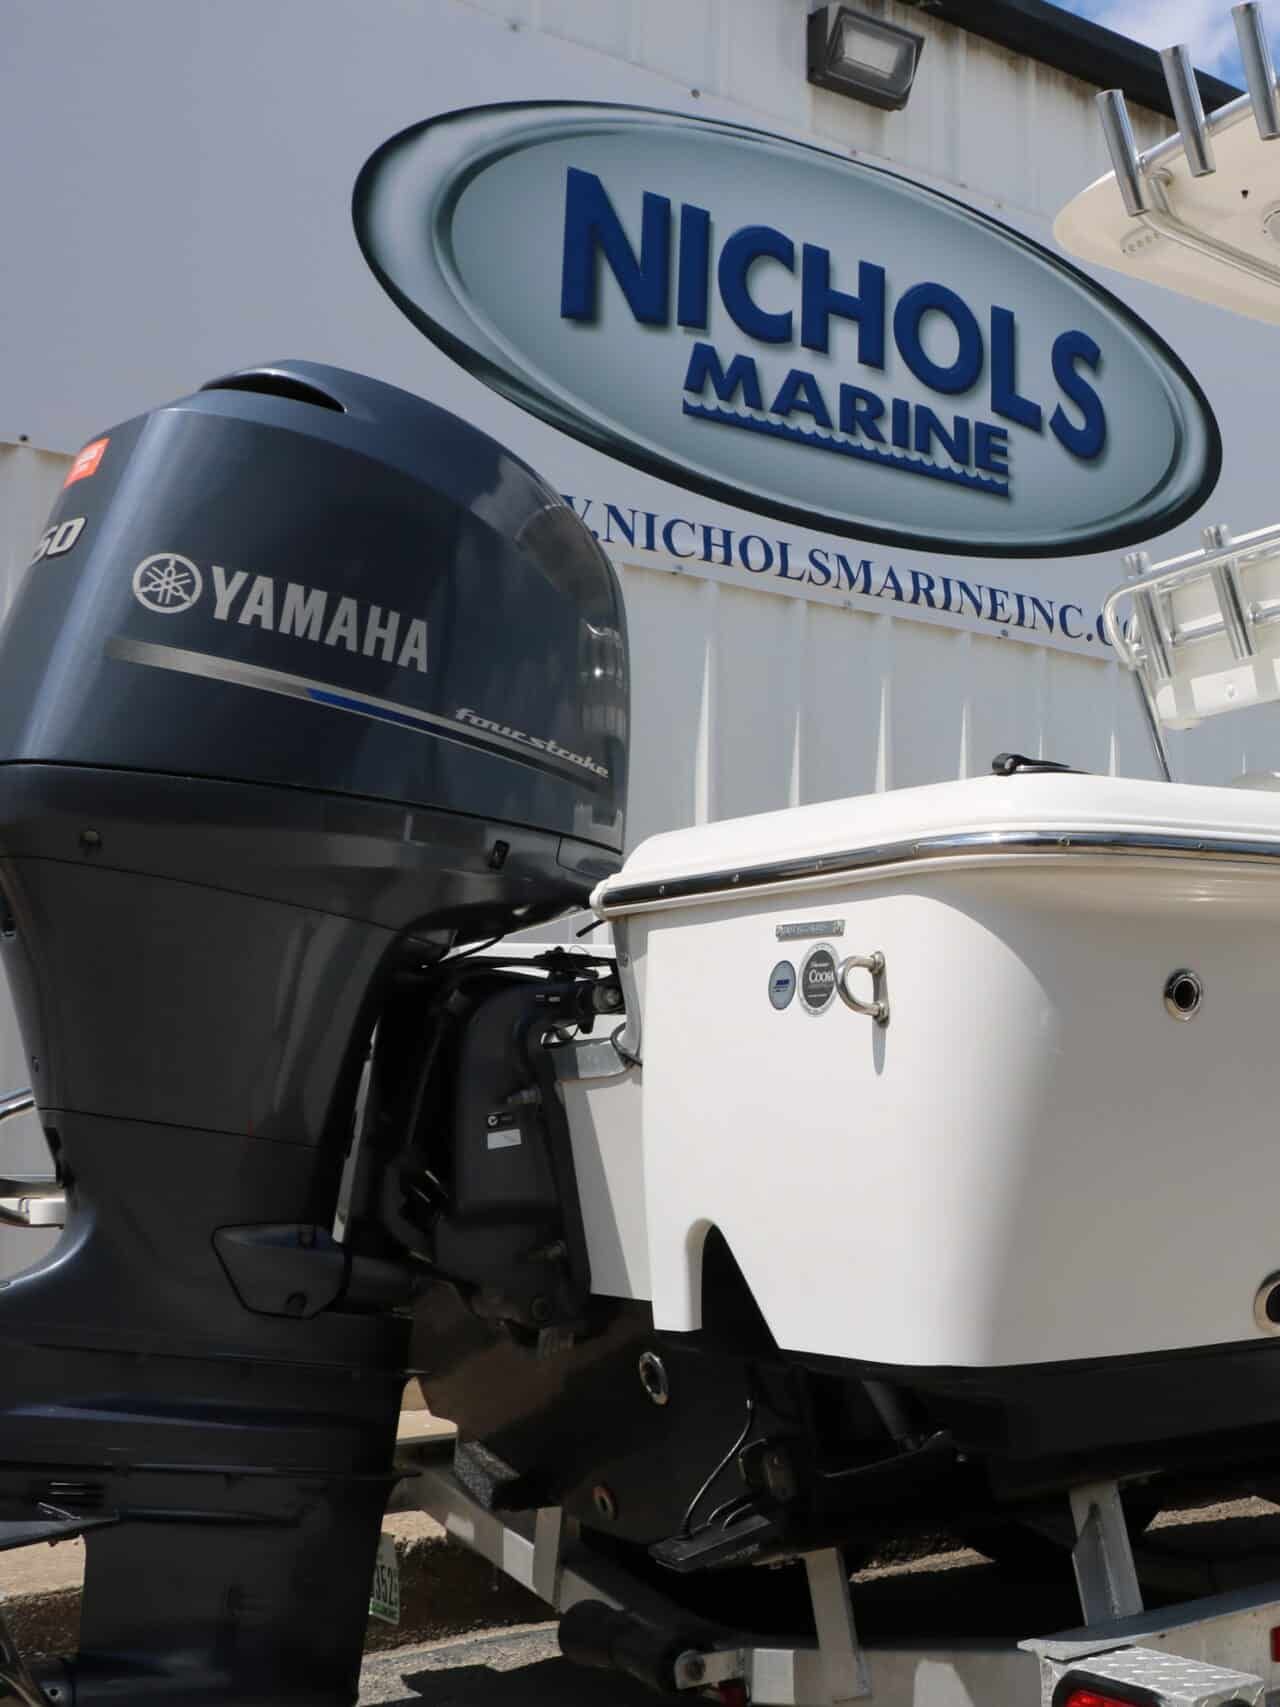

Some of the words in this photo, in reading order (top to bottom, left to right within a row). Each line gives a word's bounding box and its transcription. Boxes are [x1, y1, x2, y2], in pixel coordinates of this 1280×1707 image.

[561, 166, 1107, 460] NICHOLS
[684, 342, 1008, 475] MARINE
[211, 566, 428, 673] YAMAHA
